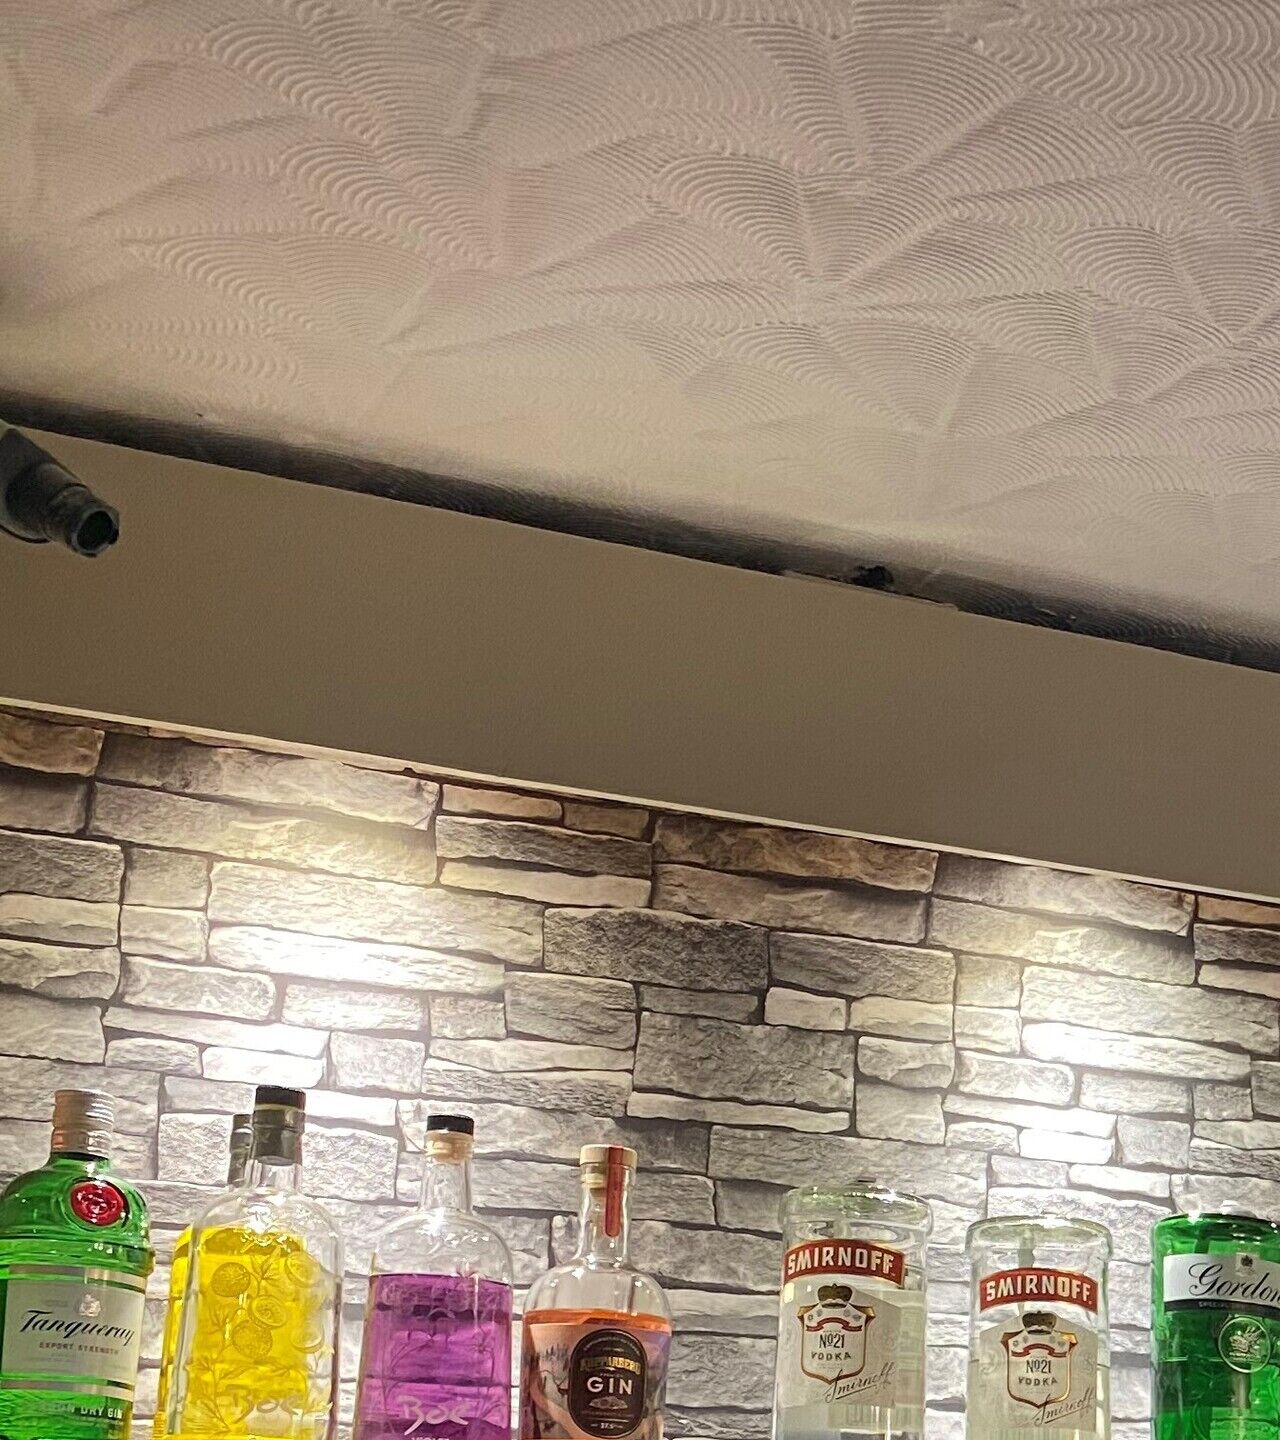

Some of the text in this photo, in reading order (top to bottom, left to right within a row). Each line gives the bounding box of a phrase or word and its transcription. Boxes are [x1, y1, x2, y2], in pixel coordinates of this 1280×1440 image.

[787, 1246, 896, 1277] SMIRNOFF
[986, 1273, 1092, 1303] SMIRNOFF
[20, 1309, 135, 1347] Tanqueray
[39, 1342, 119, 1355] EXPORT STRENGTH
[811, 1352, 853, 1362] VODKA
[586, 1375, 633, 1396] GIN
[1018, 1376, 1059, 1387] VODKA
[107, 1408, 123, 1419] GIN
